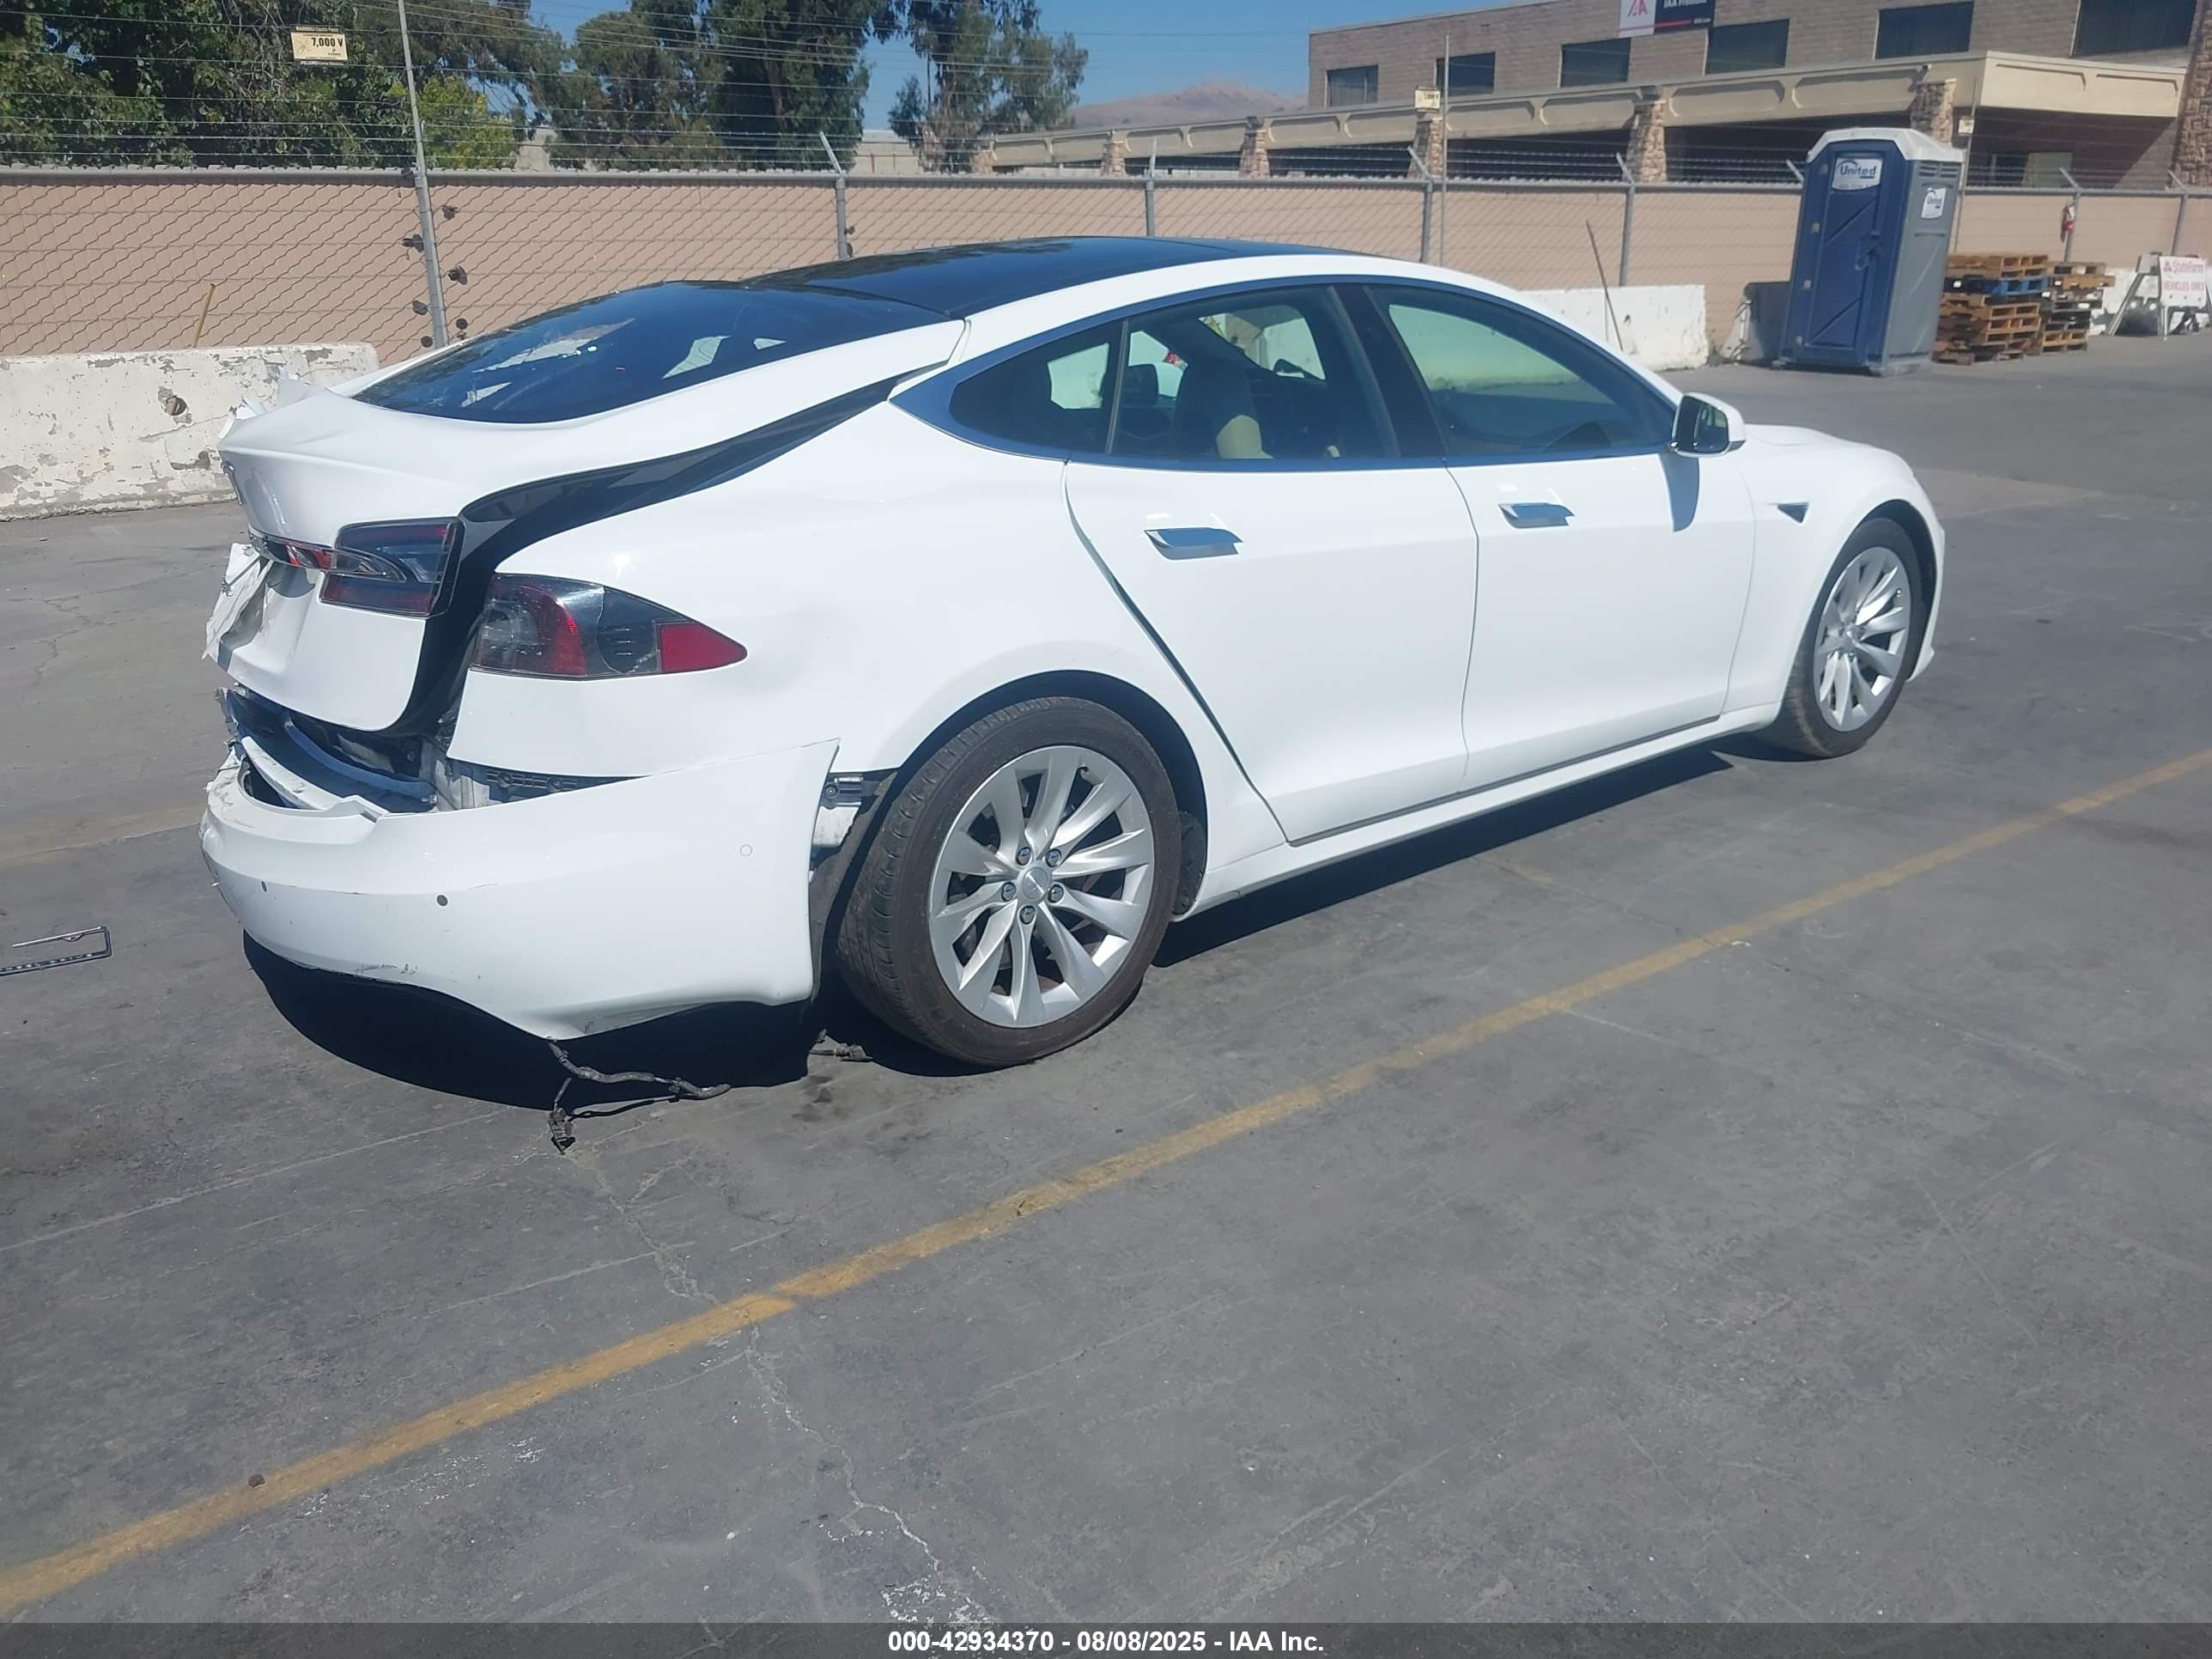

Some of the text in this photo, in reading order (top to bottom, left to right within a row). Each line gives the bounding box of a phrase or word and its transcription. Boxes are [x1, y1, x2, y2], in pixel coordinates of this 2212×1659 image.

[311, 37, 343, 47] 7,000 V
[1840, 165, 1877, 176] United
